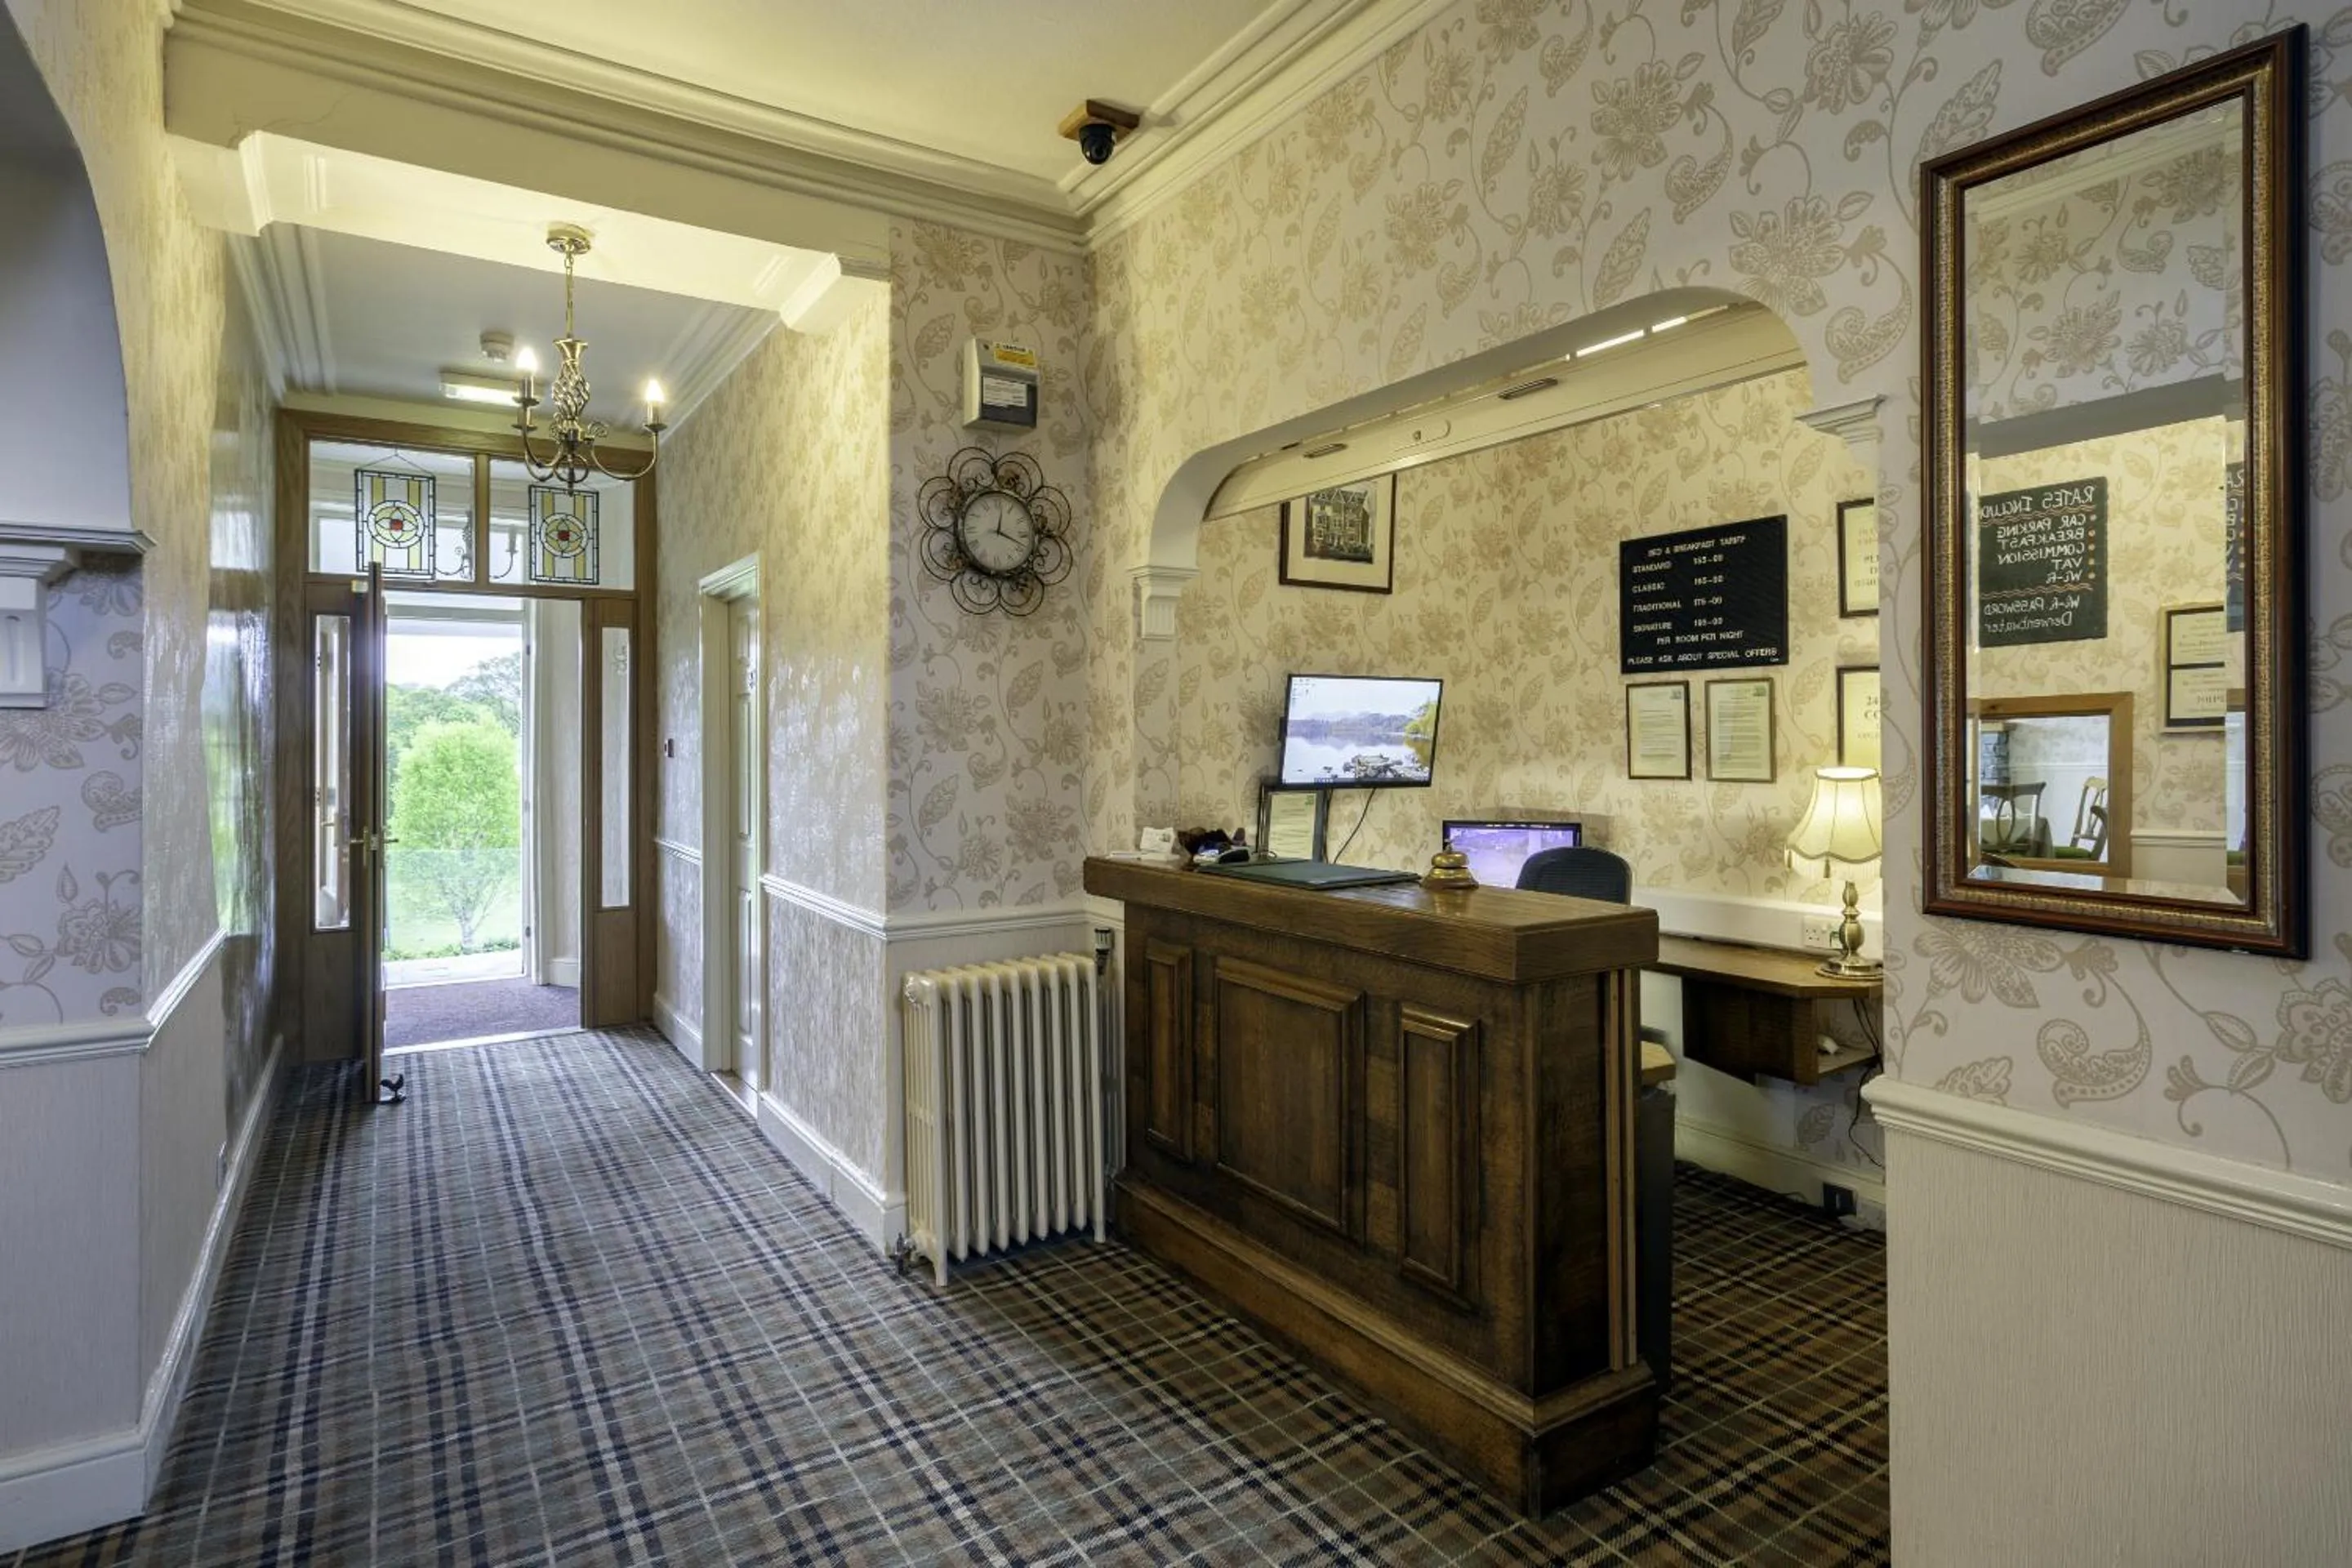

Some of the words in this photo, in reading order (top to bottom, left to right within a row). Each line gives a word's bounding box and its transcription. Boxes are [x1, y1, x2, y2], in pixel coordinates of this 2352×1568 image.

[1633, 560, 1673, 573] STANDARD
[1632, 581, 1665, 594] CLASSIC
[1633, 599, 1682, 612] TRADITIONAL
[1633, 621, 1673, 633] SIGNATURE
[1675, 634, 1699, 644] ROOM
[1700, 632, 1717, 642] PER
[1719, 630, 1744, 640] NIGHT
[1627, 657, 1654, 666] PLEASE
[1658, 655, 1673, 663] ASK
[1677, 653, 1703, 662] ABOUT
[1707, 650, 1740, 660] SPECIAL
[1744, 647, 1778, 658] OFFERS
